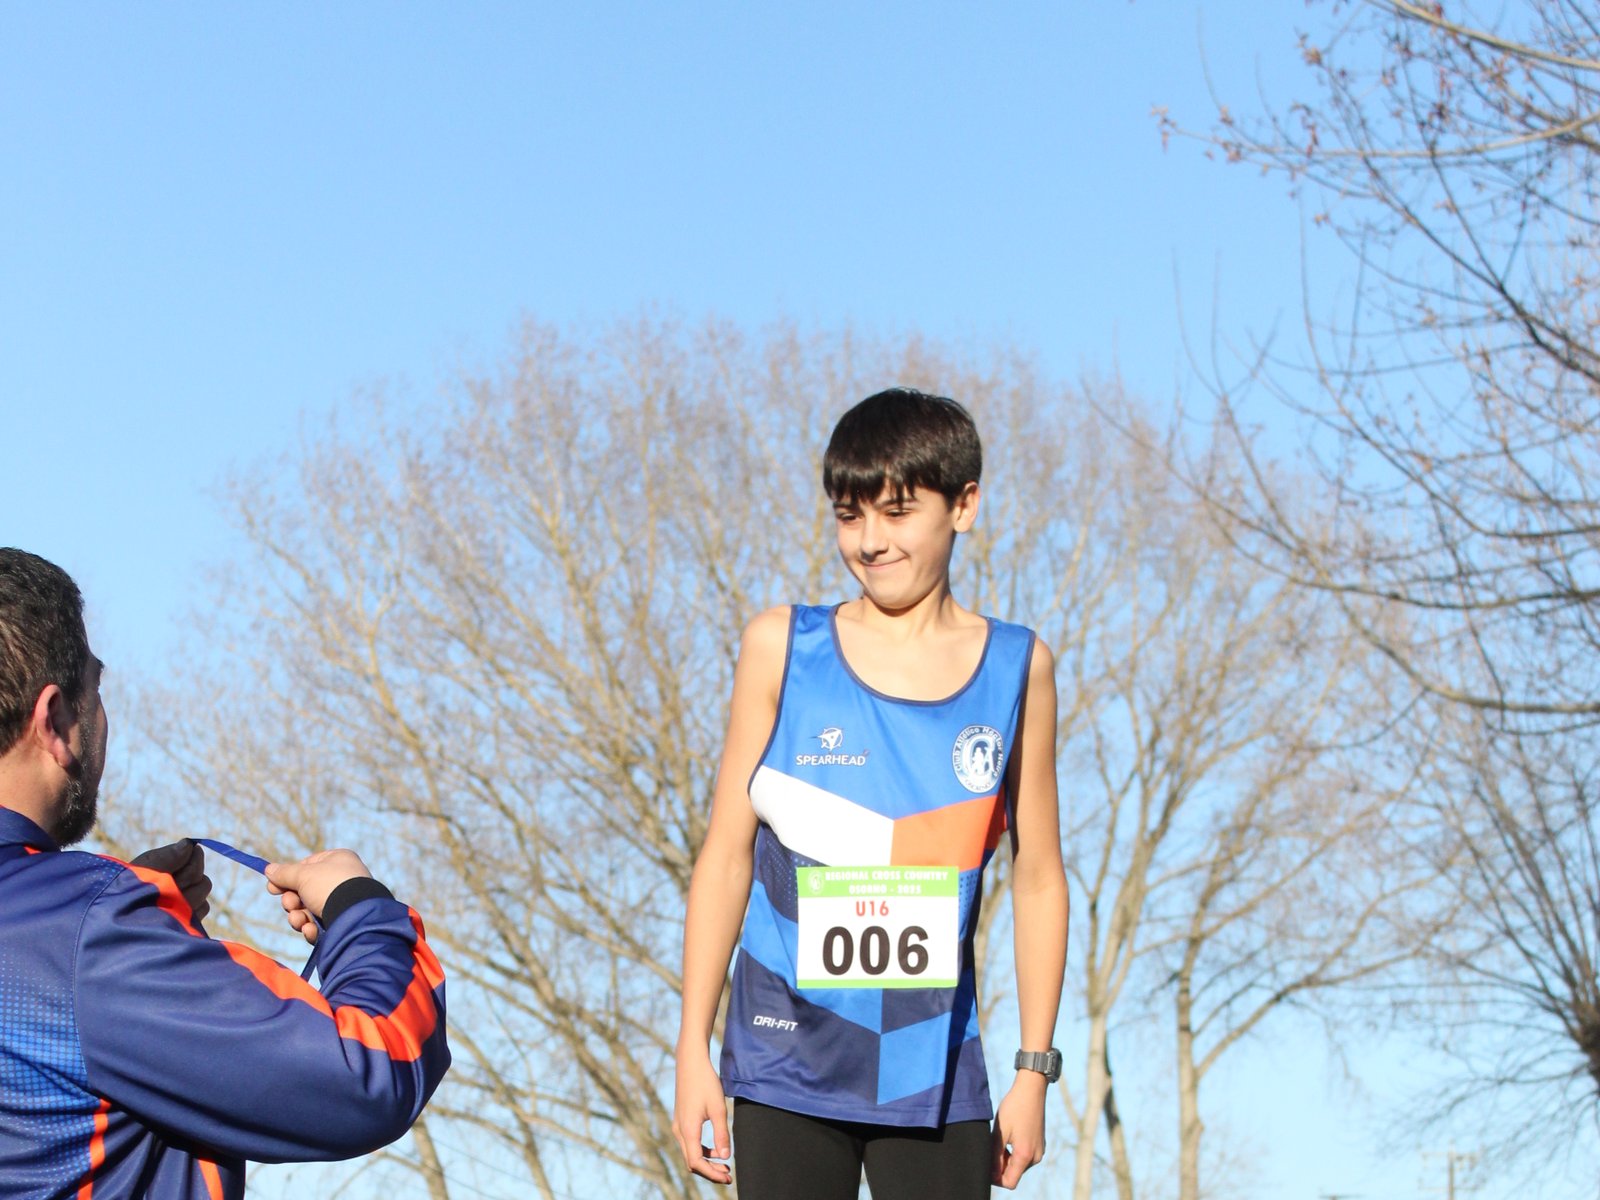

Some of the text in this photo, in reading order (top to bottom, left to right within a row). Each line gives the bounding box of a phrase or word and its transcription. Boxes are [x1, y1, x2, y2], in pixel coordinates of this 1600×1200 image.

[796, 754, 866, 766] SPEARHEAD
[825, 870, 948, 881] REGIONAL CROSS COUNTRY
[848, 884, 887, 894] OSORNO
[855, 901, 889, 917] U16
[822, 925, 929, 976] 006
[753, 1015, 798, 1031] DRI-FIT
